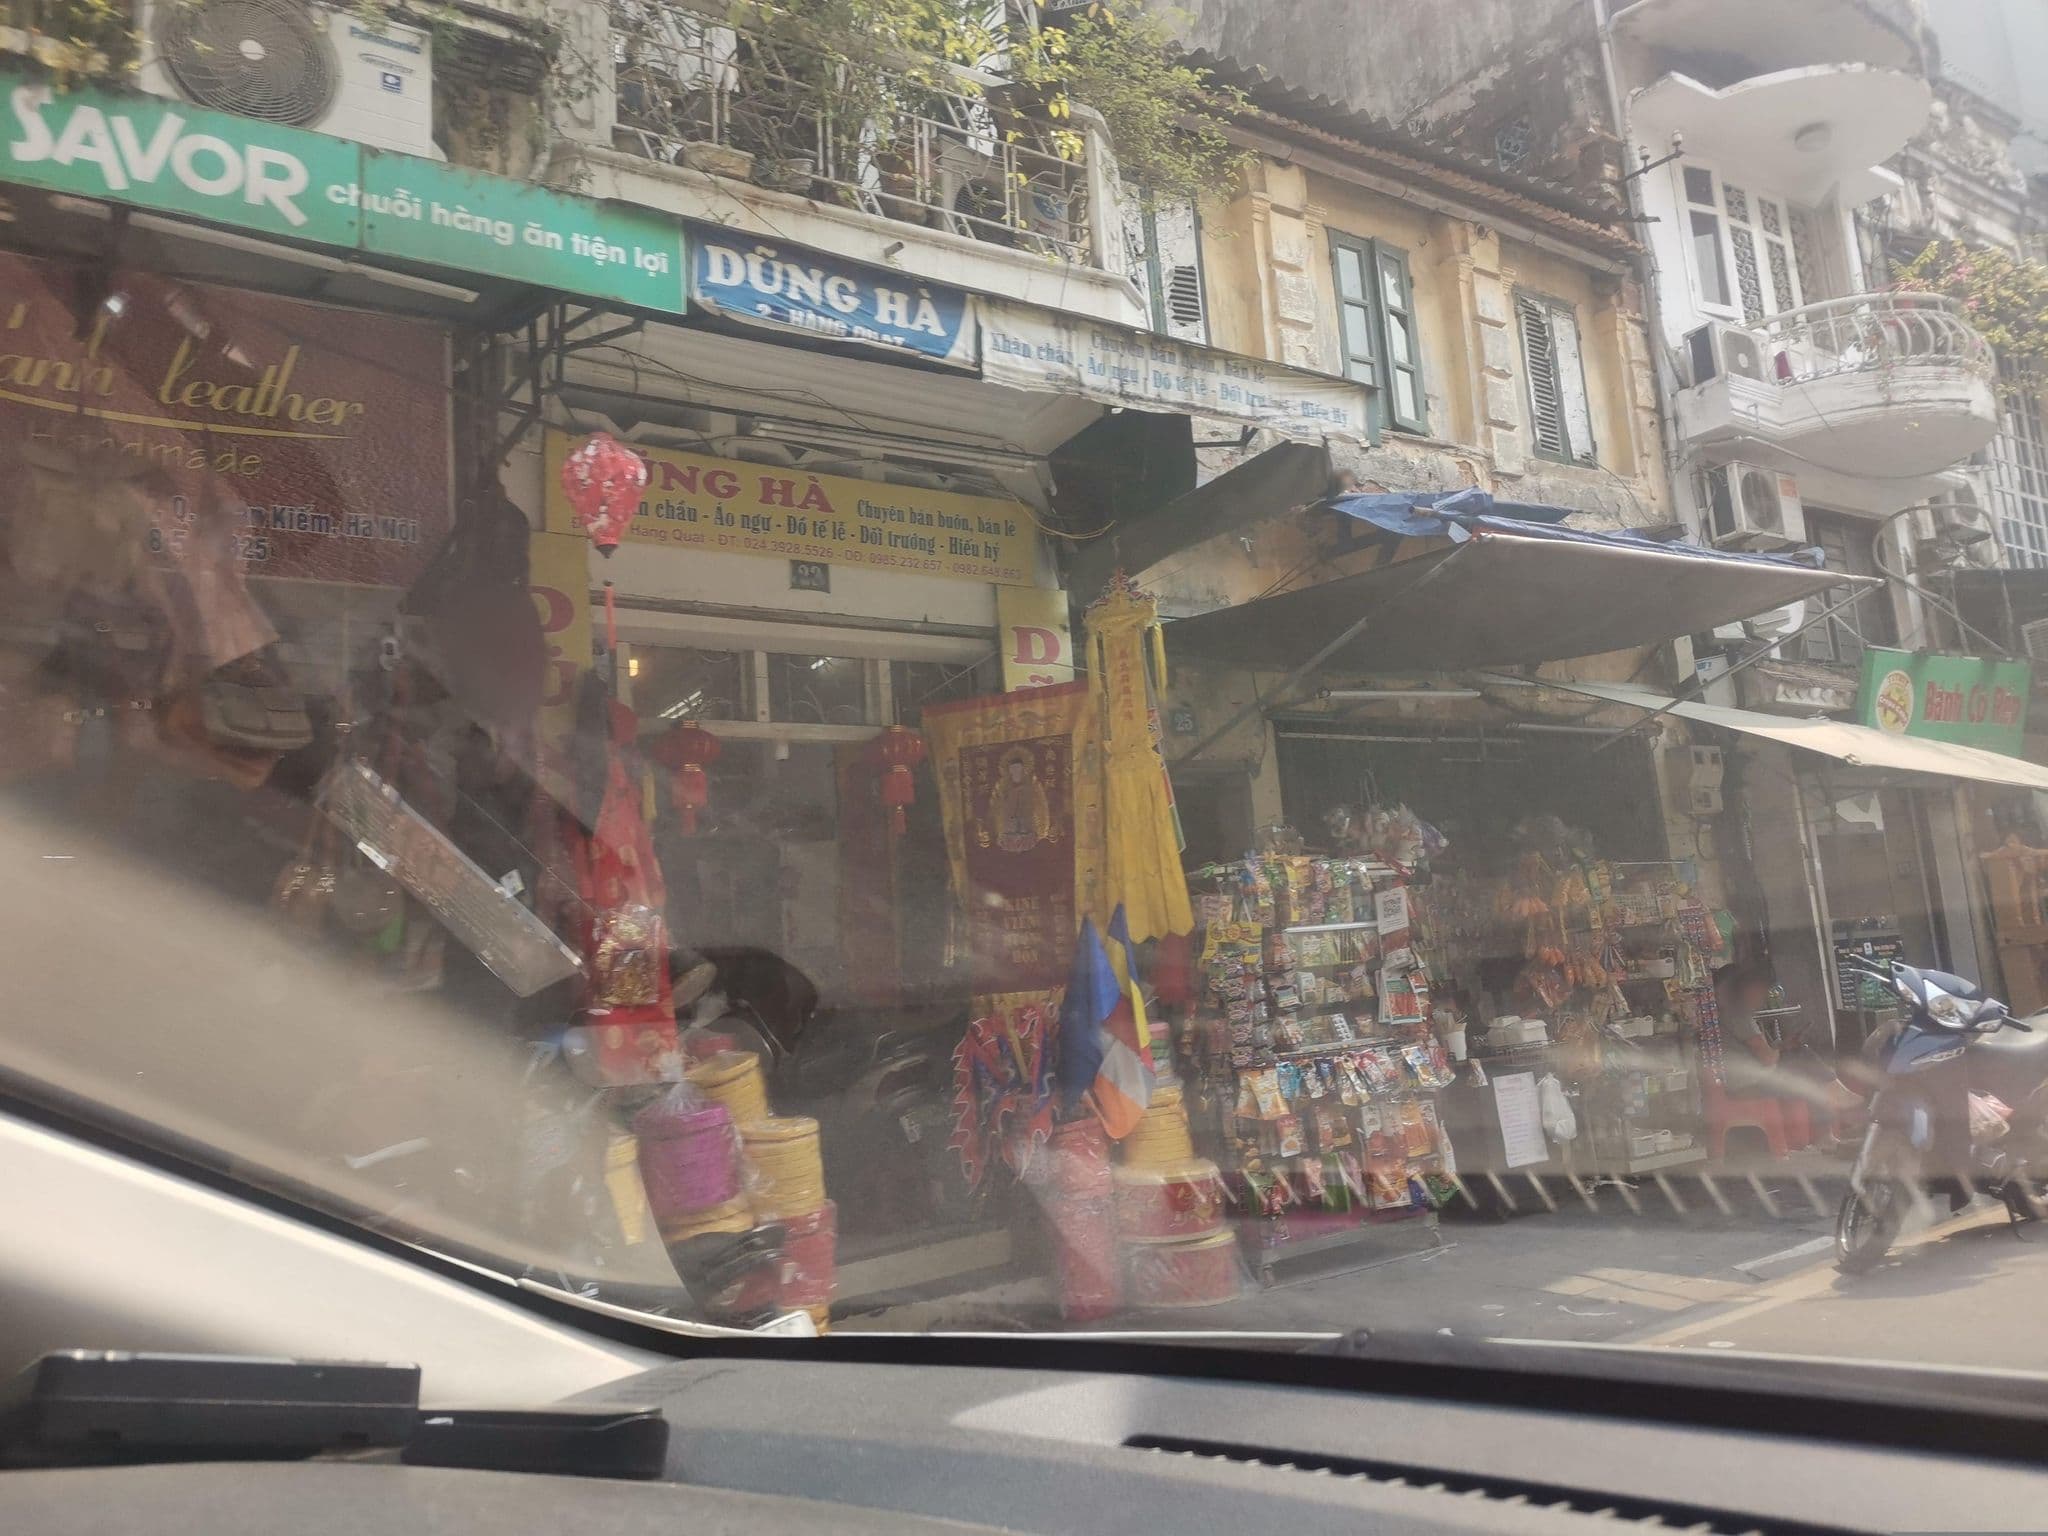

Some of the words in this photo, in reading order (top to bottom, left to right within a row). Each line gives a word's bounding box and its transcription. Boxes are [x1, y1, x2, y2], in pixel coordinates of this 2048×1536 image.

[11, 87, 309, 226] SAVOR
[326, 181, 422, 221] chuỗi
[430, 203, 515, 248] hàng
[523, 220, 562, 251] ăn
[570, 231, 627, 267] tiện
[634, 246, 668, 278] lợi
[705, 245, 860, 313] DŨNG
[874, 288, 947, 337] HÀ
[160, 338, 365, 426] leather
[714, 502, 735, 527] Áo
[758, 475, 835, 513] HÀ
[857, 499, 904, 523] Chuyên
